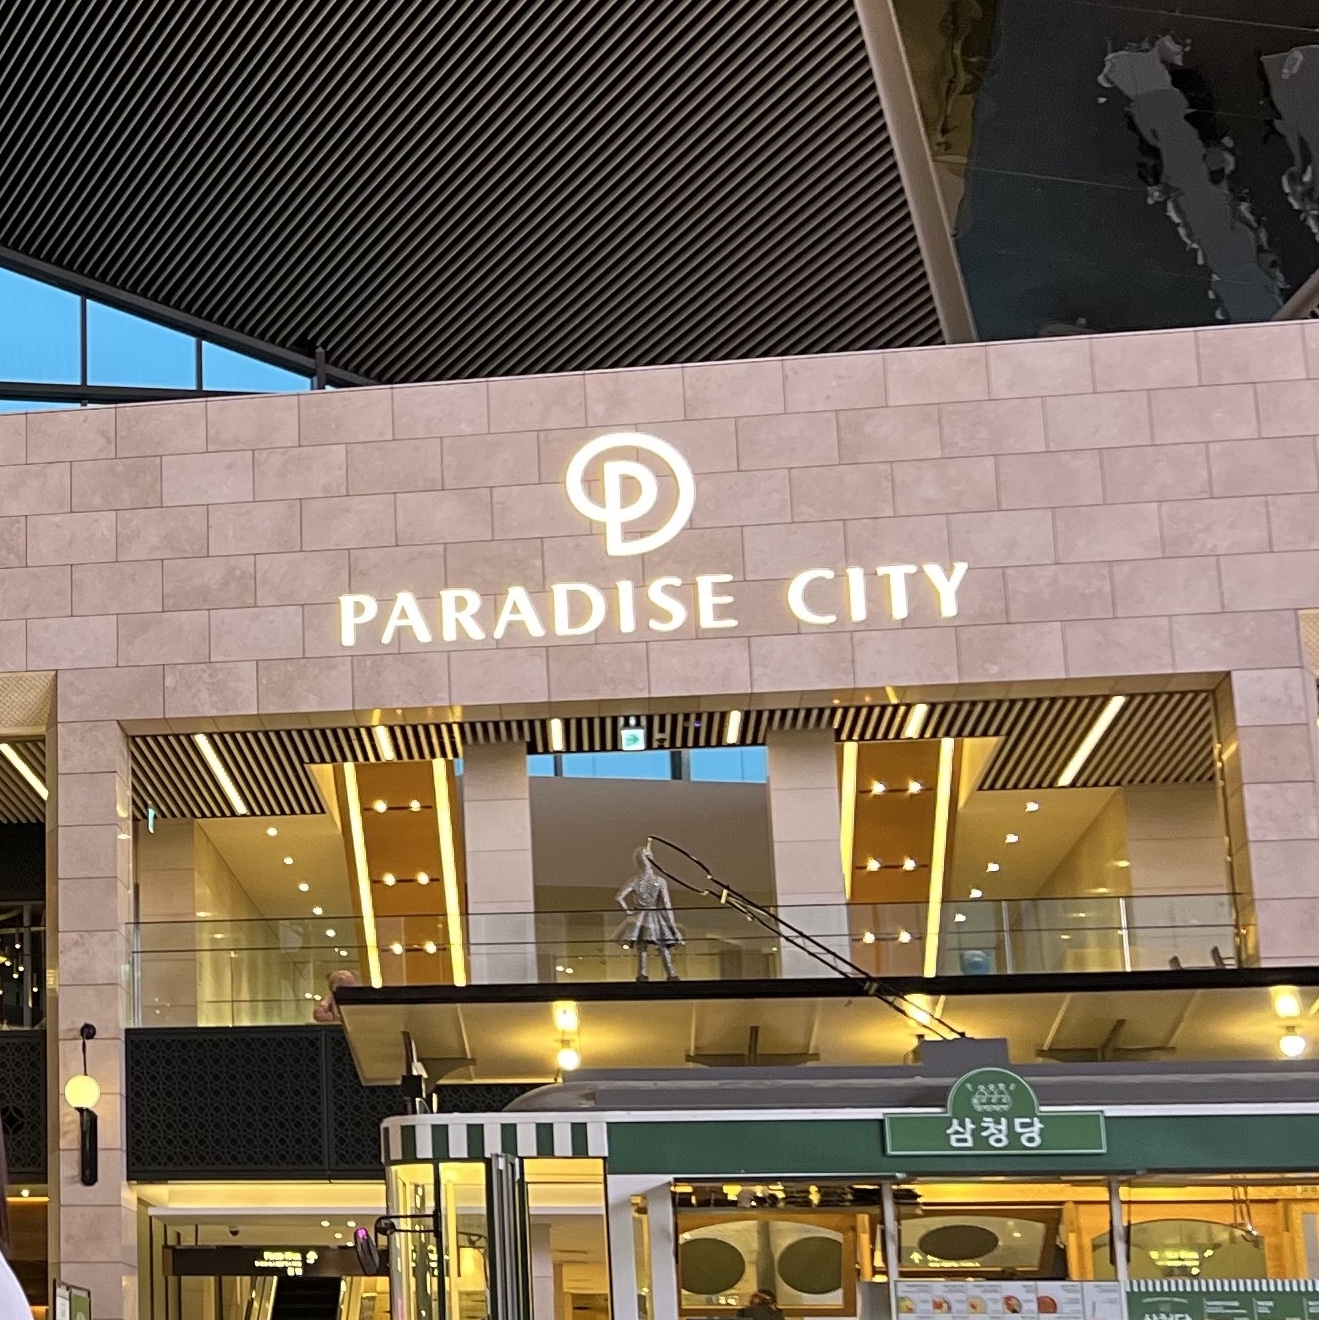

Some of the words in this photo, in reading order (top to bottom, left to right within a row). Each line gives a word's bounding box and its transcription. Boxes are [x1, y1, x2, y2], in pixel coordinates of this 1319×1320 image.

[338, 573, 739, 647] PARADISE
[787, 560, 970, 625] CITY
[945, 1116, 1045, 1148] 삼청당
